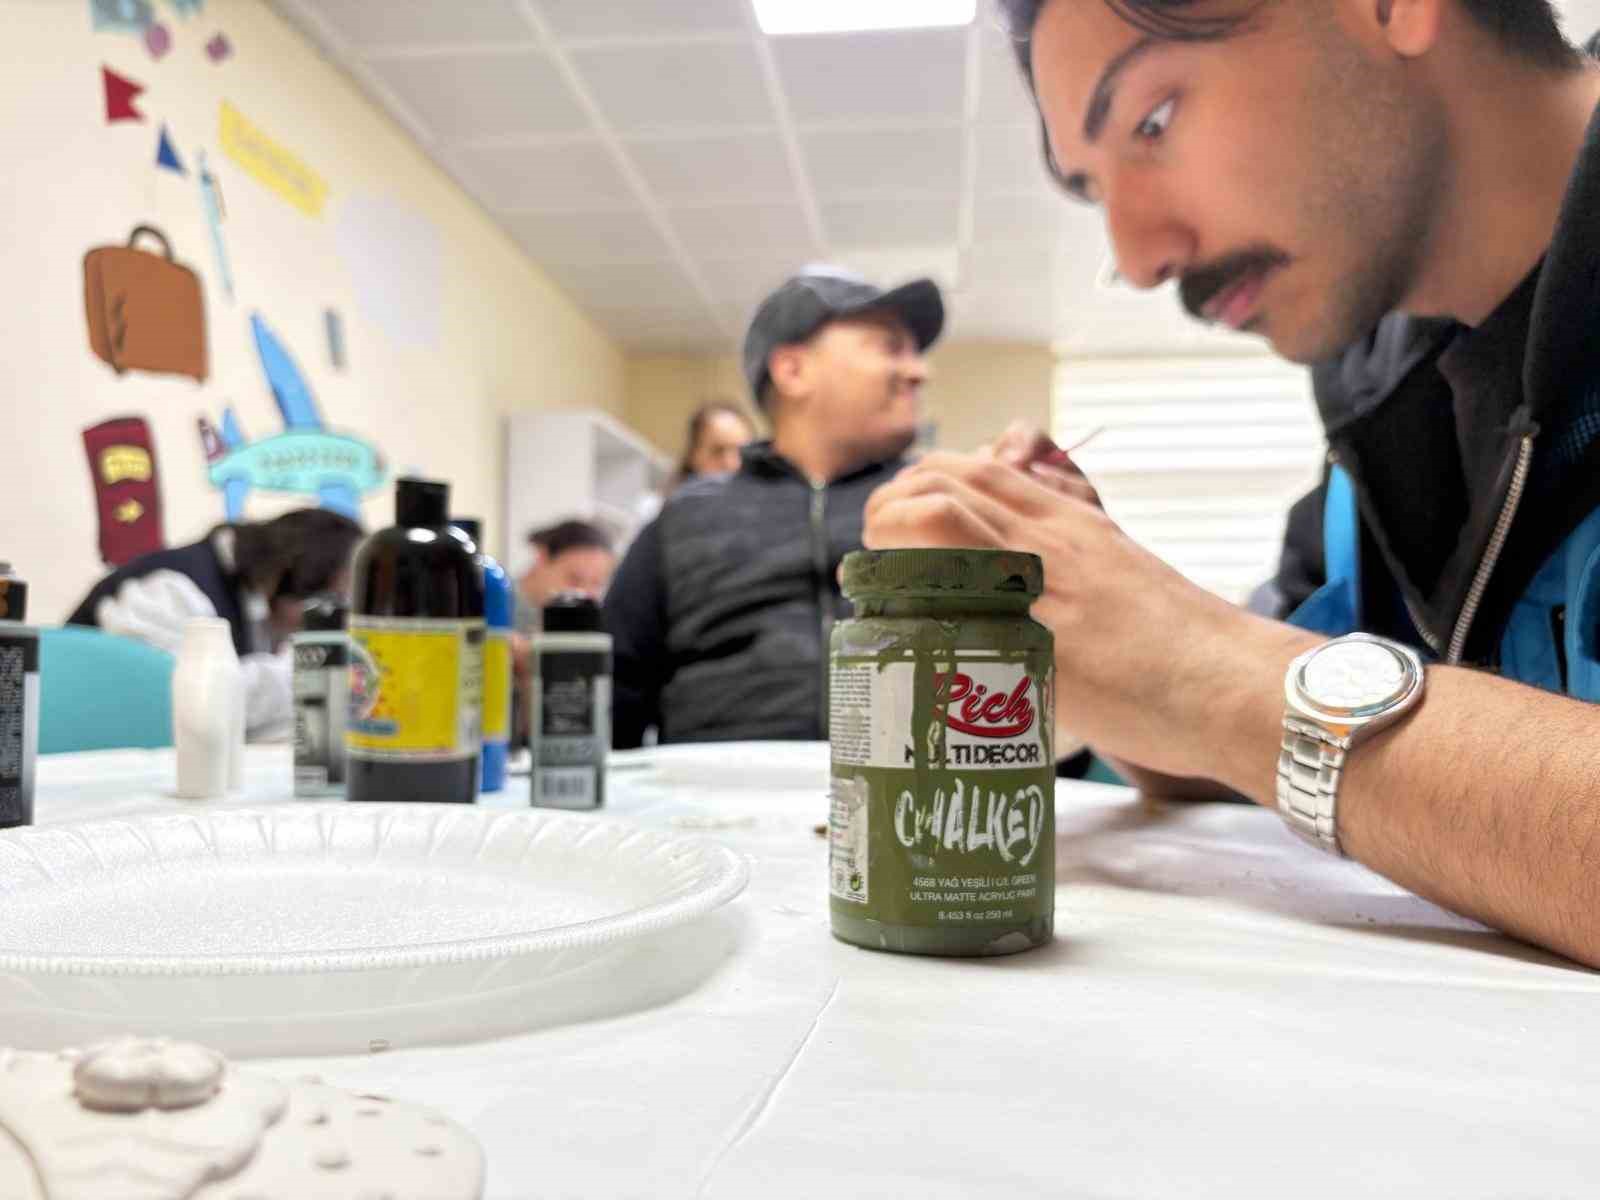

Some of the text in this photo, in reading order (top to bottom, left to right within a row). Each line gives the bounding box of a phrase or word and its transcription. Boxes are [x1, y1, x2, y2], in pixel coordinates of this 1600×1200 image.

[910, 891, 942, 902] ULTRA
[943, 891, 976, 902] MATTE
[978, 890, 1015, 902] ACRYLIC
